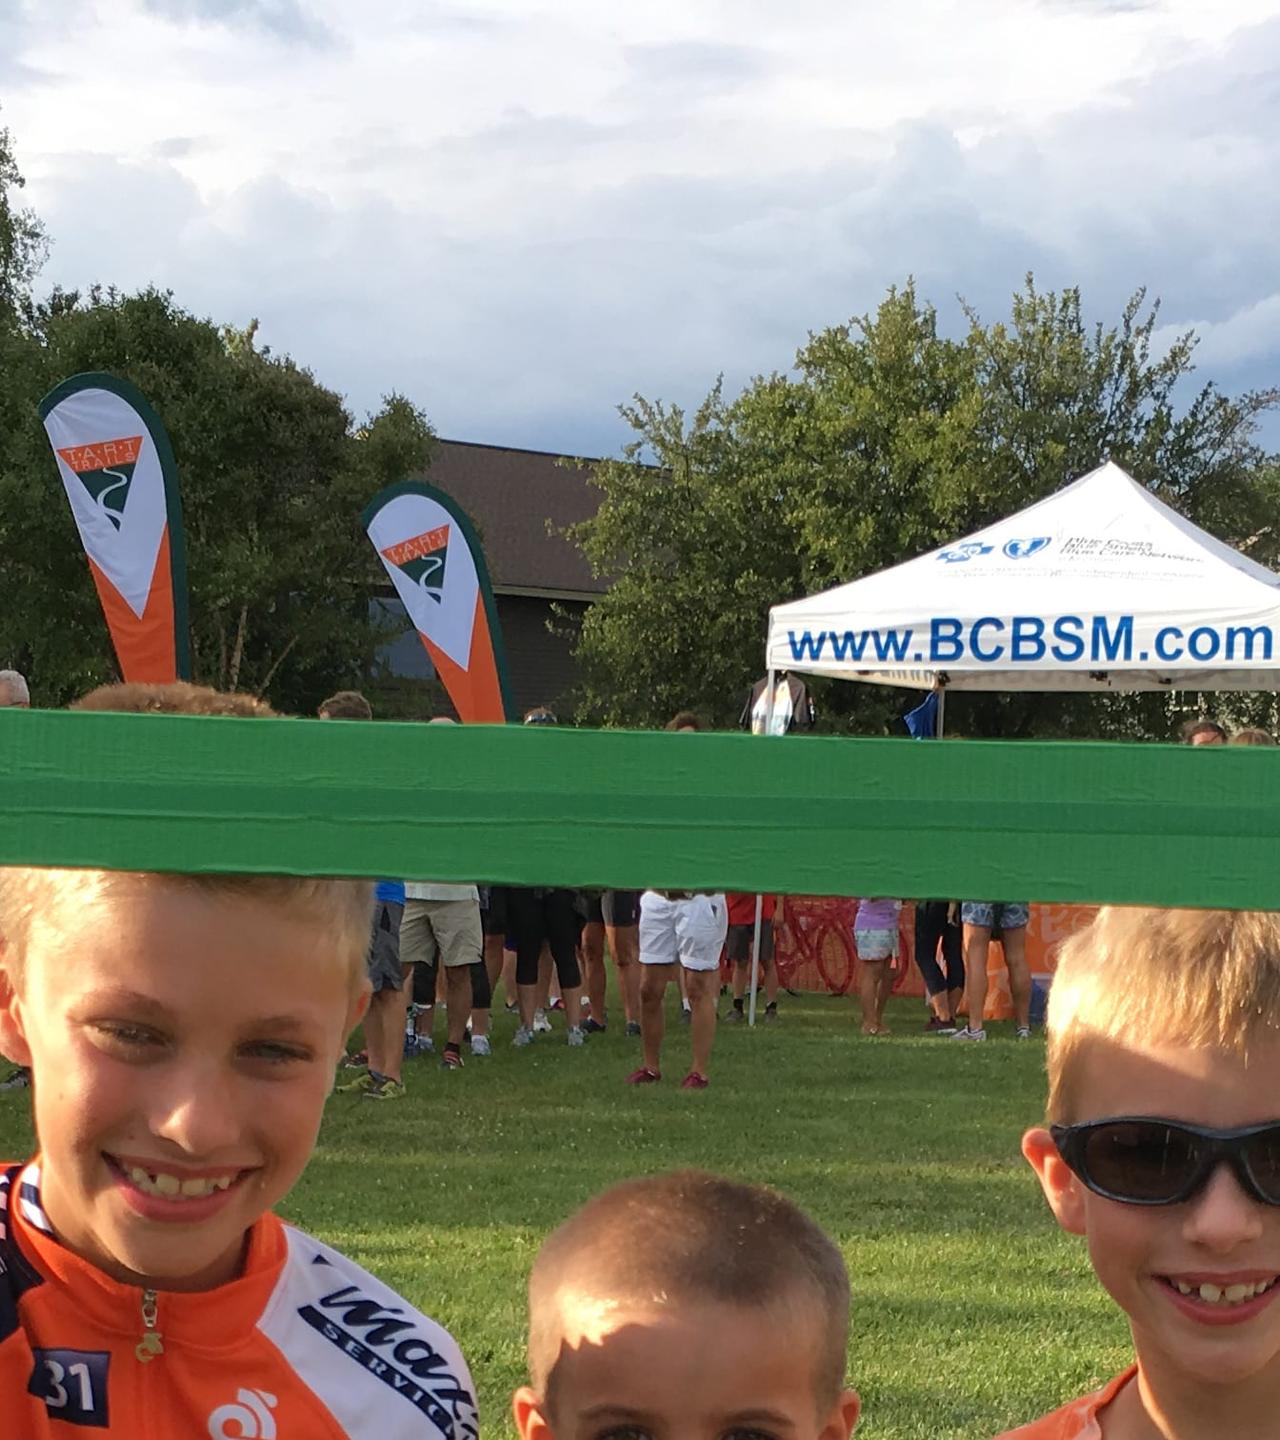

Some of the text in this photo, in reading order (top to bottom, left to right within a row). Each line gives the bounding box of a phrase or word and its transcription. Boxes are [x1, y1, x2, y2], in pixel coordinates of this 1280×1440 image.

[71, 452, 136, 470] TRAILS
[788, 615, 1274, 662] www.BCBSM.com
[43, 1360, 95, 1412] 31
